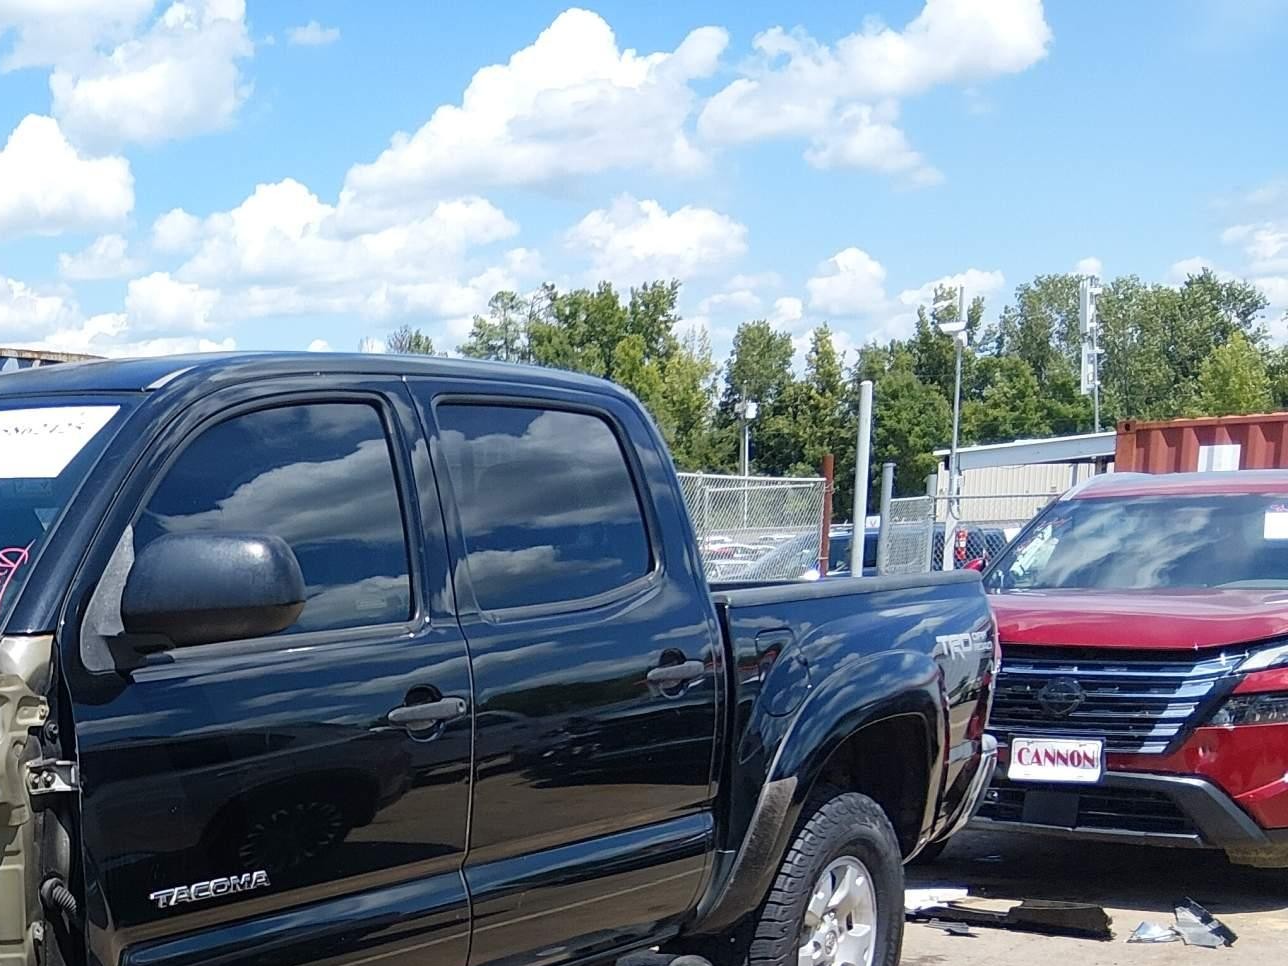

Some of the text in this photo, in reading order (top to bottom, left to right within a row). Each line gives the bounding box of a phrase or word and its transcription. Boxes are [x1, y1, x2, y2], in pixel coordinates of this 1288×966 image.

[936, 633, 972, 660] TRD
[1017, 747, 1096, 768] CANNON
[149, 869, 271, 908] TACOMA
